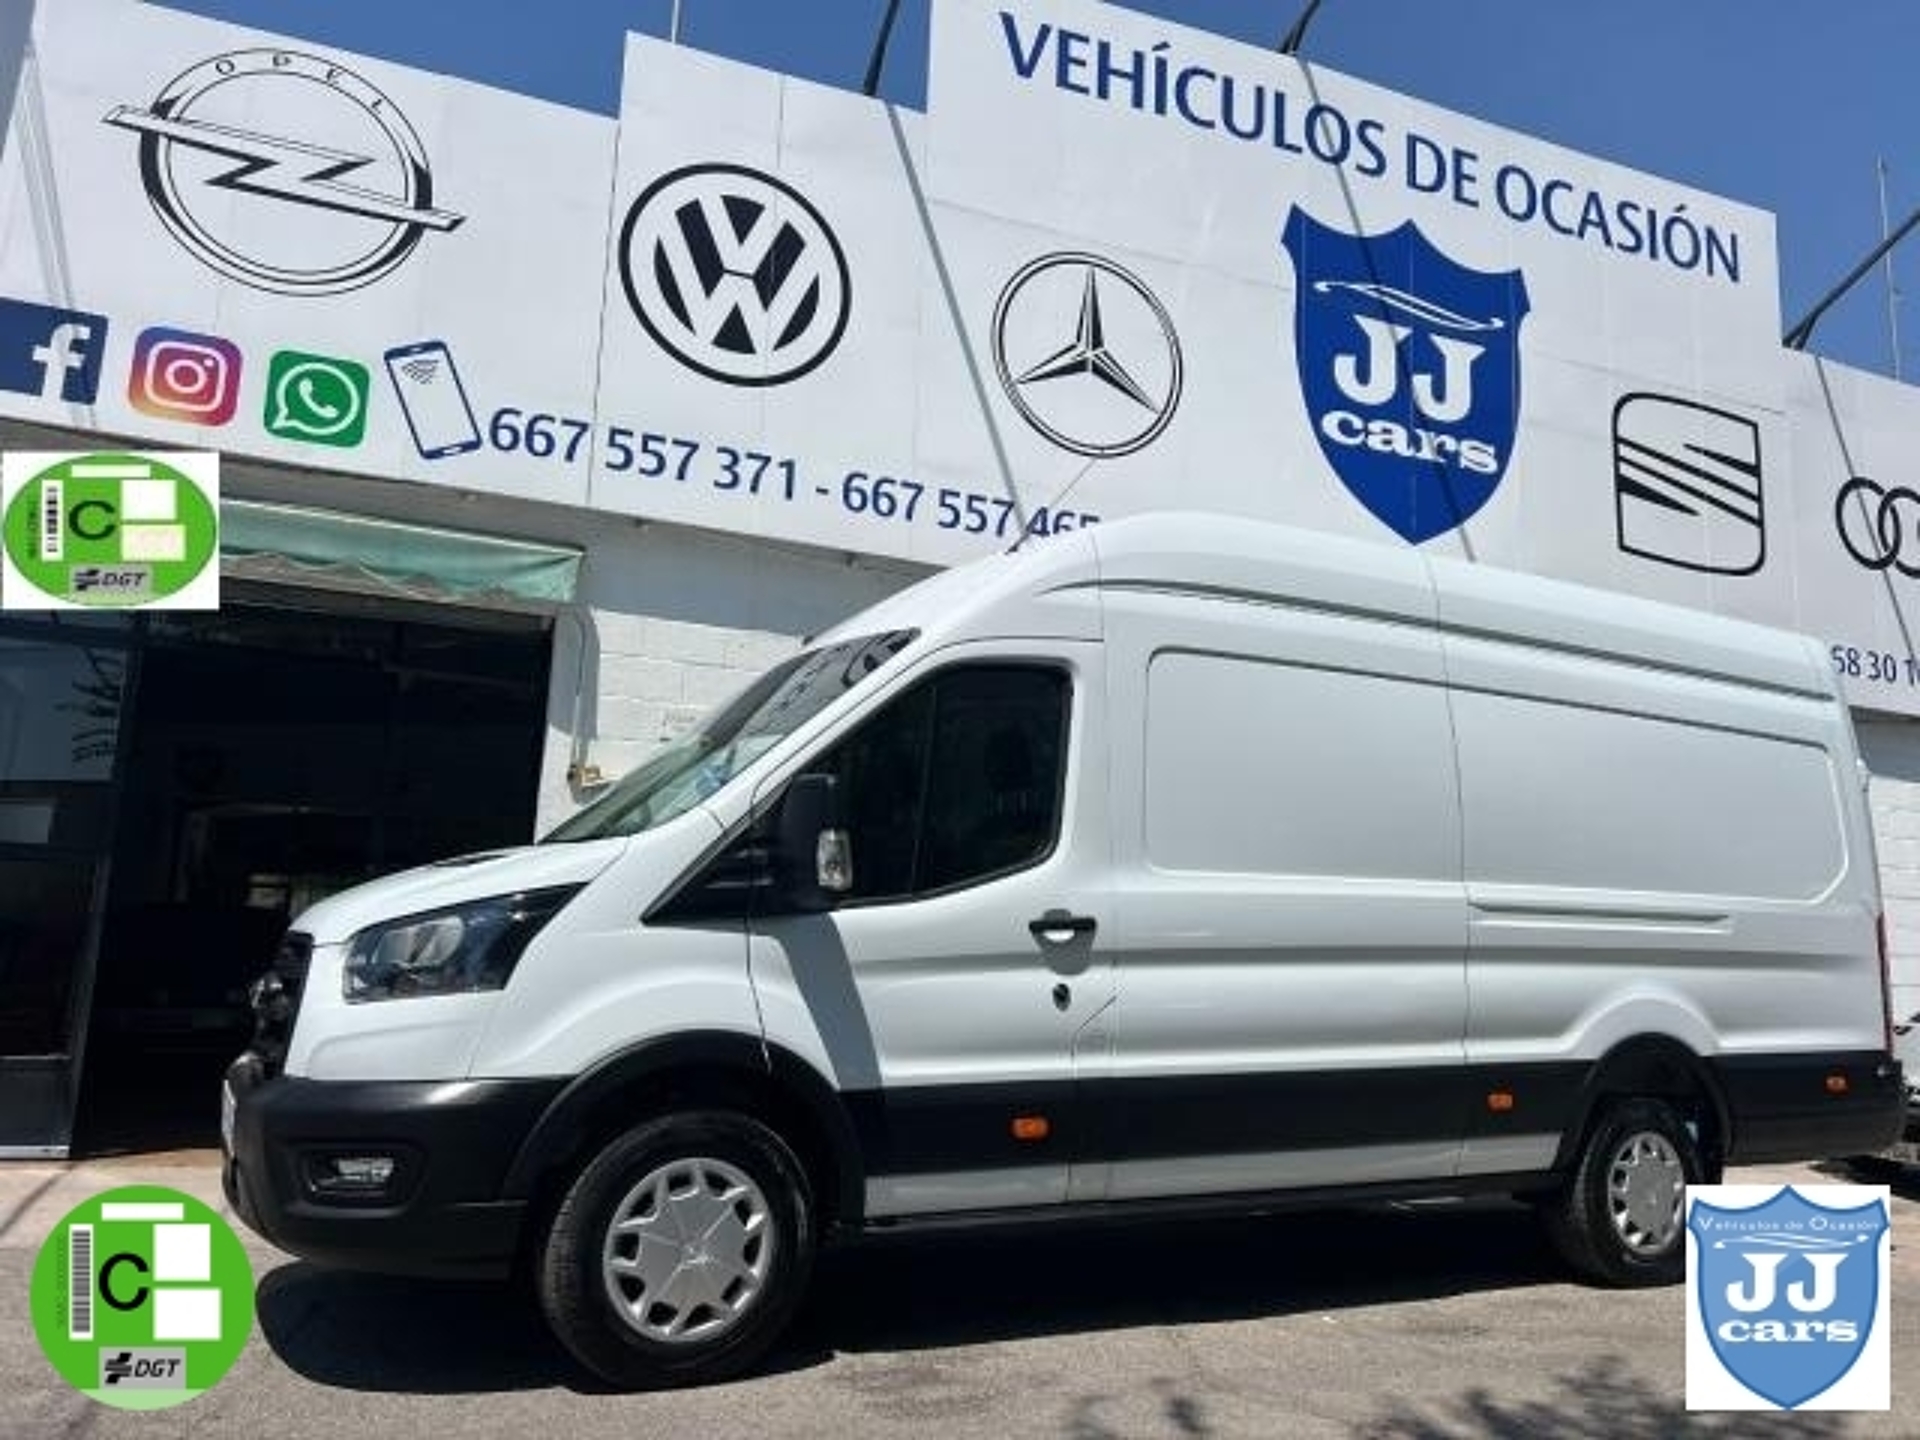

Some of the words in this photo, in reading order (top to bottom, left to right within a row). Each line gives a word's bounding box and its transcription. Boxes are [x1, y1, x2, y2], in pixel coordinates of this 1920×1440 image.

[1000, 11, 1387, 177] VEHÍCULOS
[1406, 132, 1479, 208] DE
[1496, 164, 1740, 283] OCASIÓN
[1334, 314, 1487, 422] JJ
[489, 407, 590, 463] 667
[605, 426, 700, 481] 557
[713, 446, 797, 499] 371
[842, 472, 925, 522] 667
[937, 488, 1015, 538] 557
[1322, 410, 1498, 474] cars
[1867, 650, 1897, 685] 30
